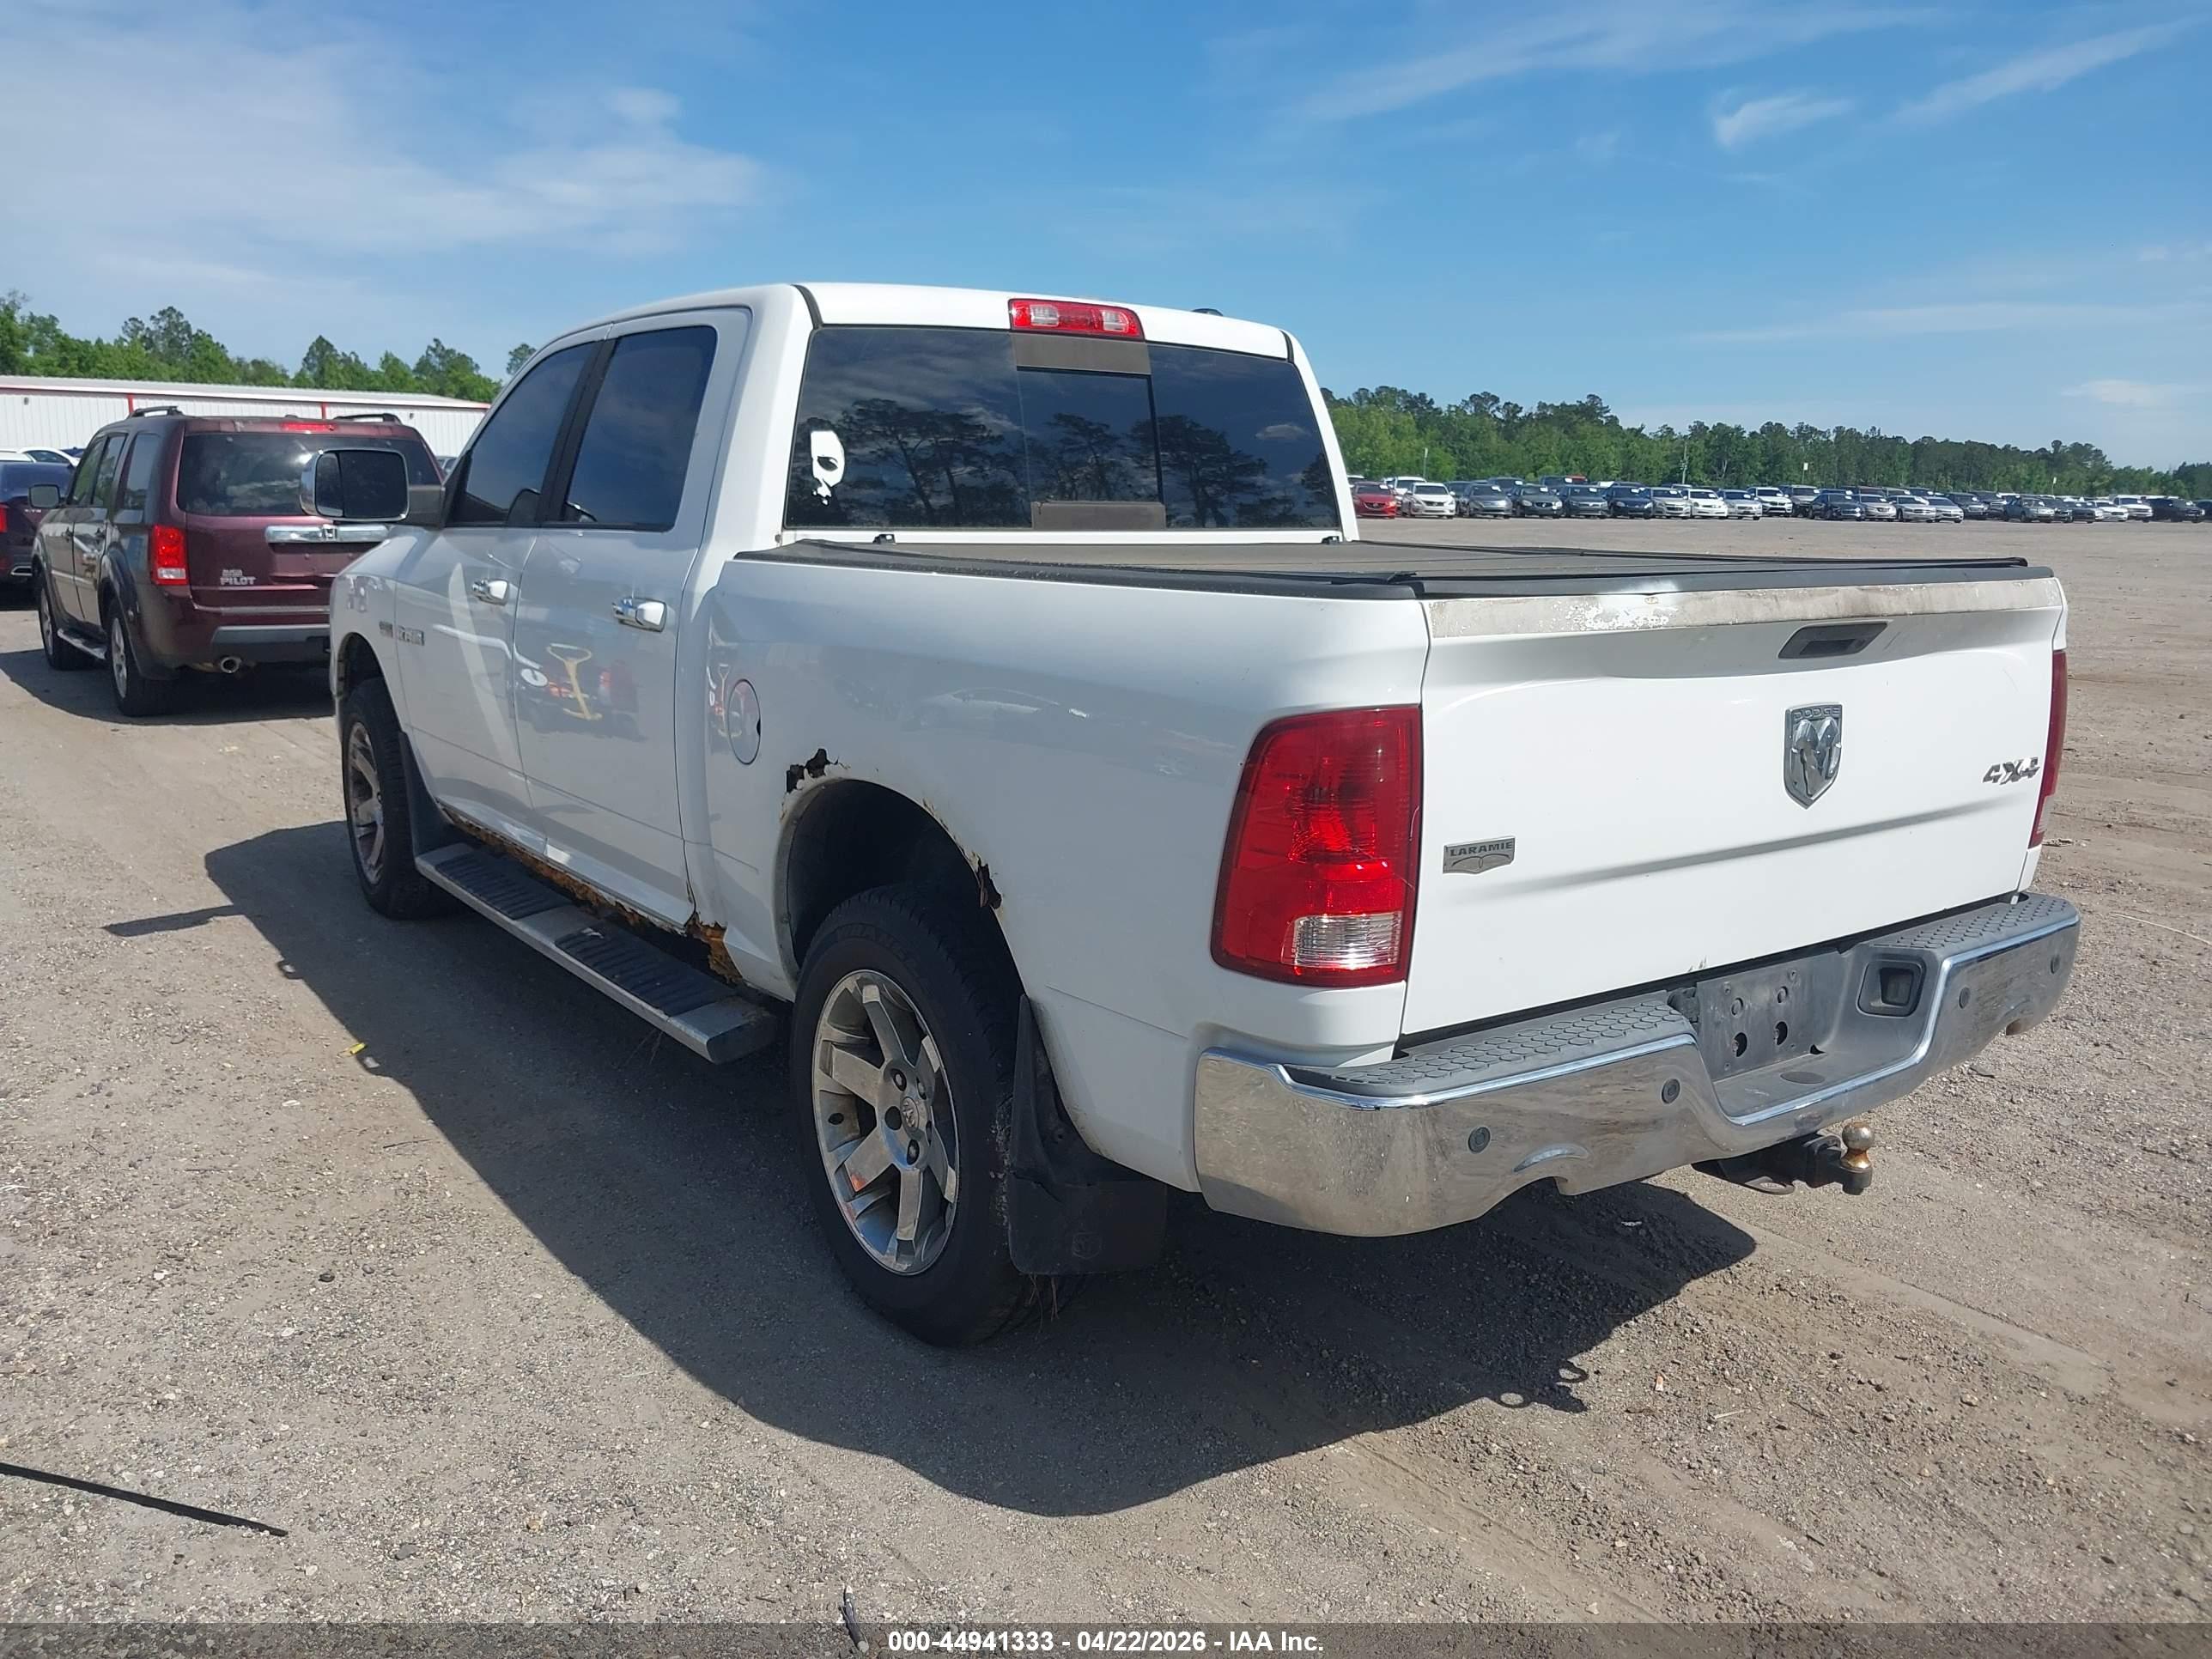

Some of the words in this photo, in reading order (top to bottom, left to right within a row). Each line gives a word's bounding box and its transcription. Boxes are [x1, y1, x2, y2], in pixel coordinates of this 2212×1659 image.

[220, 576, 256, 585] PILOT
[1793, 706, 1841, 721] DODGE
[1449, 842, 1513, 857] LARAMIE
